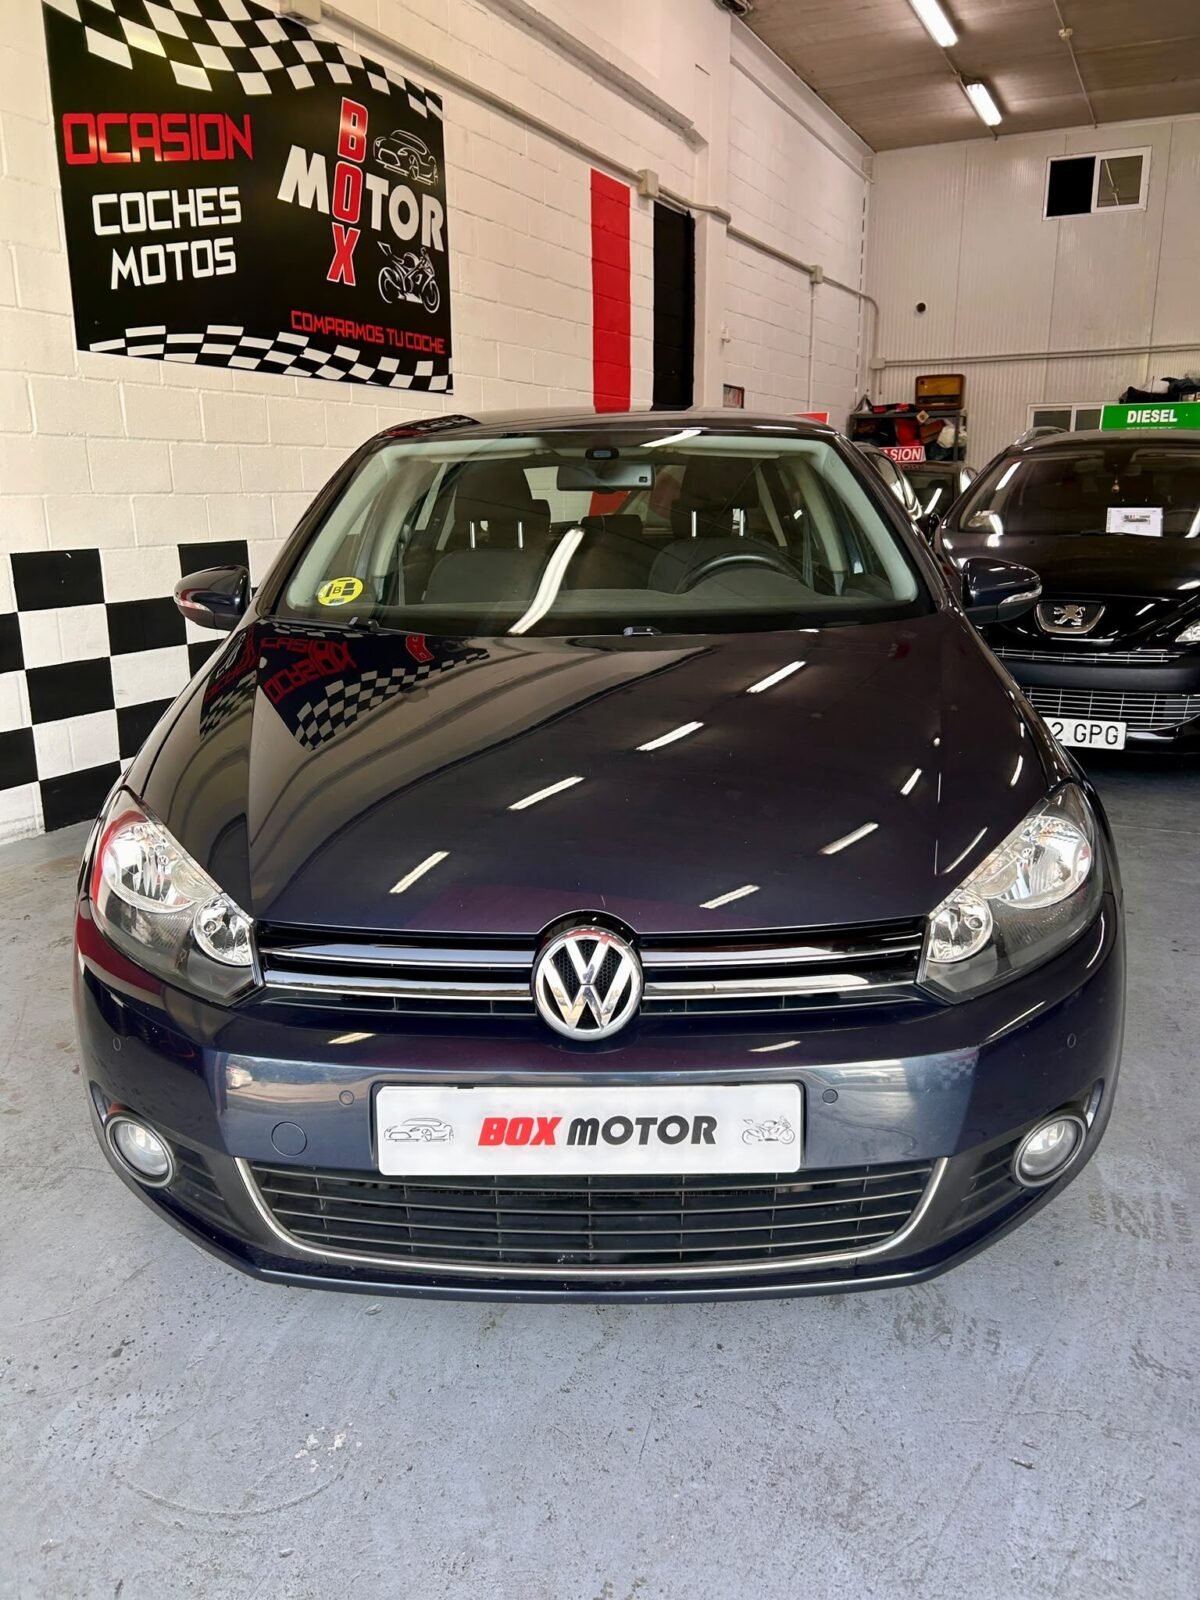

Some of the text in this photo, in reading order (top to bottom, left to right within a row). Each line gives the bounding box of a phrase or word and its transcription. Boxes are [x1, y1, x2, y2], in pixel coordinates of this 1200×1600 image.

[62, 112, 253, 165] OCASION
[92, 186, 242, 236] COCHES
[326, 96, 369, 287] BOX
[110, 237, 237, 290] MOTOS
[291, 310, 446, 355] COMPRAMOS TU COCHE
[1126, 409, 1178, 424] DIESEL
[1073, 723, 1119, 745] GPG
[477, 1115, 718, 1146] BOX MOTOR
